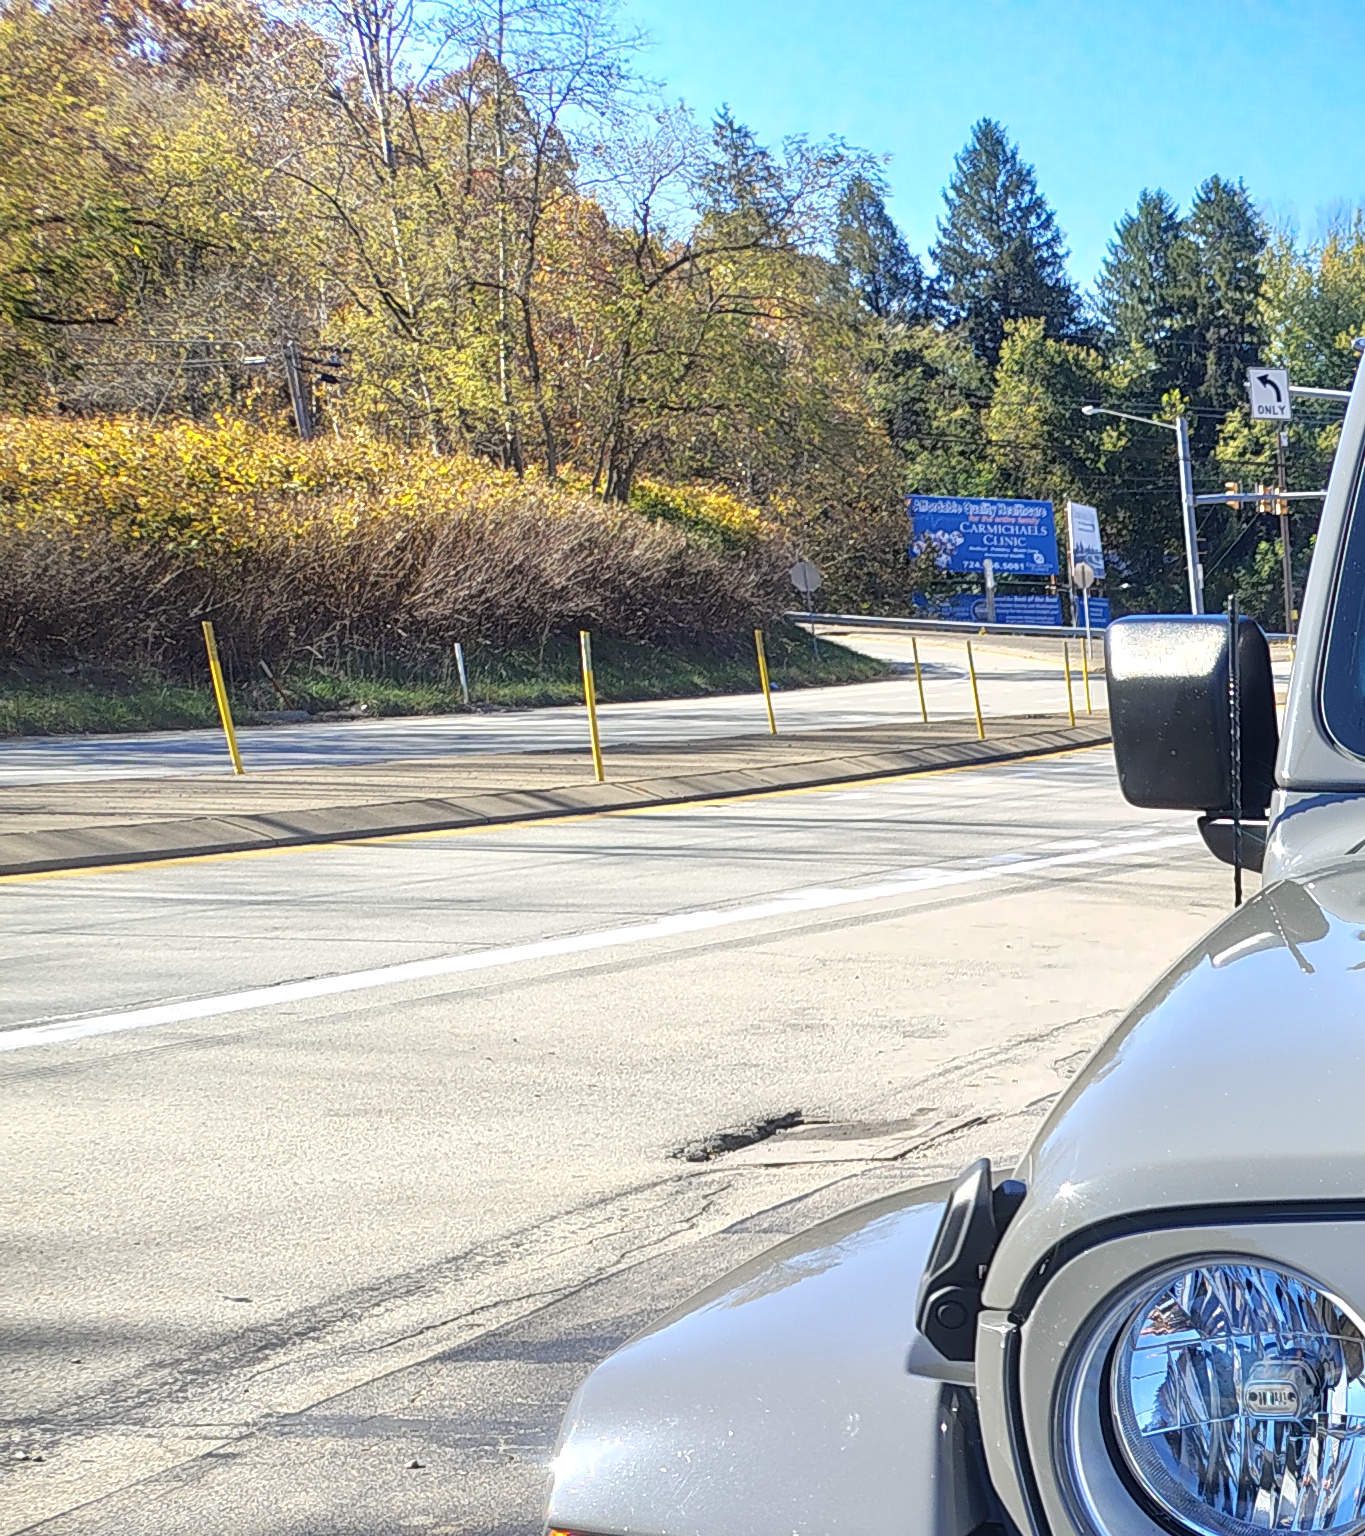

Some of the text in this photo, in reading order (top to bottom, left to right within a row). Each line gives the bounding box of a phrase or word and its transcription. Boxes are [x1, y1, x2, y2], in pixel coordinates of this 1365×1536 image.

[1257, 404, 1287, 416] ONLY
[959, 521, 1048, 537] CARMICHAELS
[982, 534, 1028, 547] CLINIC
